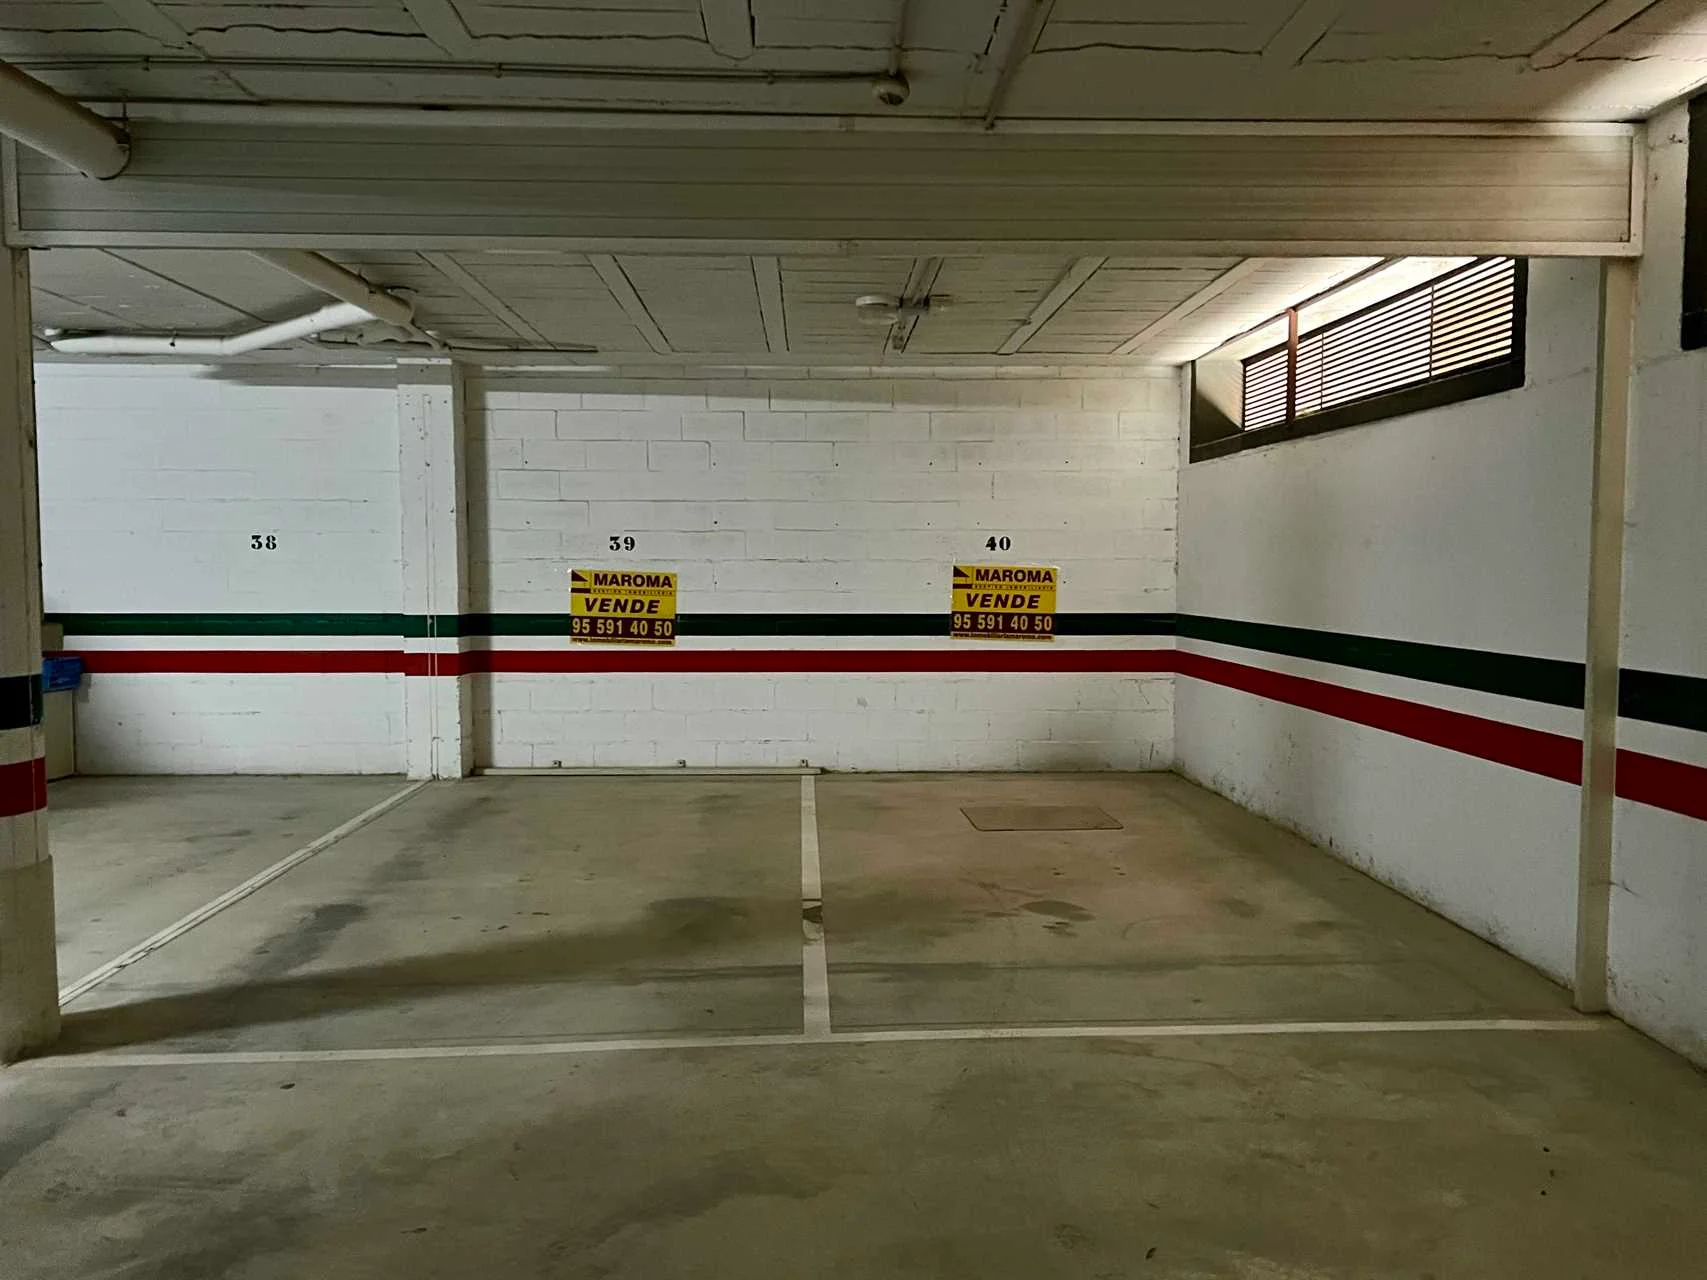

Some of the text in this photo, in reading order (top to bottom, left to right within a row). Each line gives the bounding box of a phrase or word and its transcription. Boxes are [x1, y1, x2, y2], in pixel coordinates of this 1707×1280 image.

[251, 535, 277, 550] 38
[609, 536, 636, 551] 39
[985, 536, 1011, 551] 40
[593, 573, 673, 588] MAROMA
[975, 569, 1054, 583] MAROMA
[584, 597, 661, 614] VENDE
[966, 593, 1041, 609] VENDE
[572, 618, 672, 636] 95 591 40 50
[953, 614, 1052, 631] 95 591 40 50
